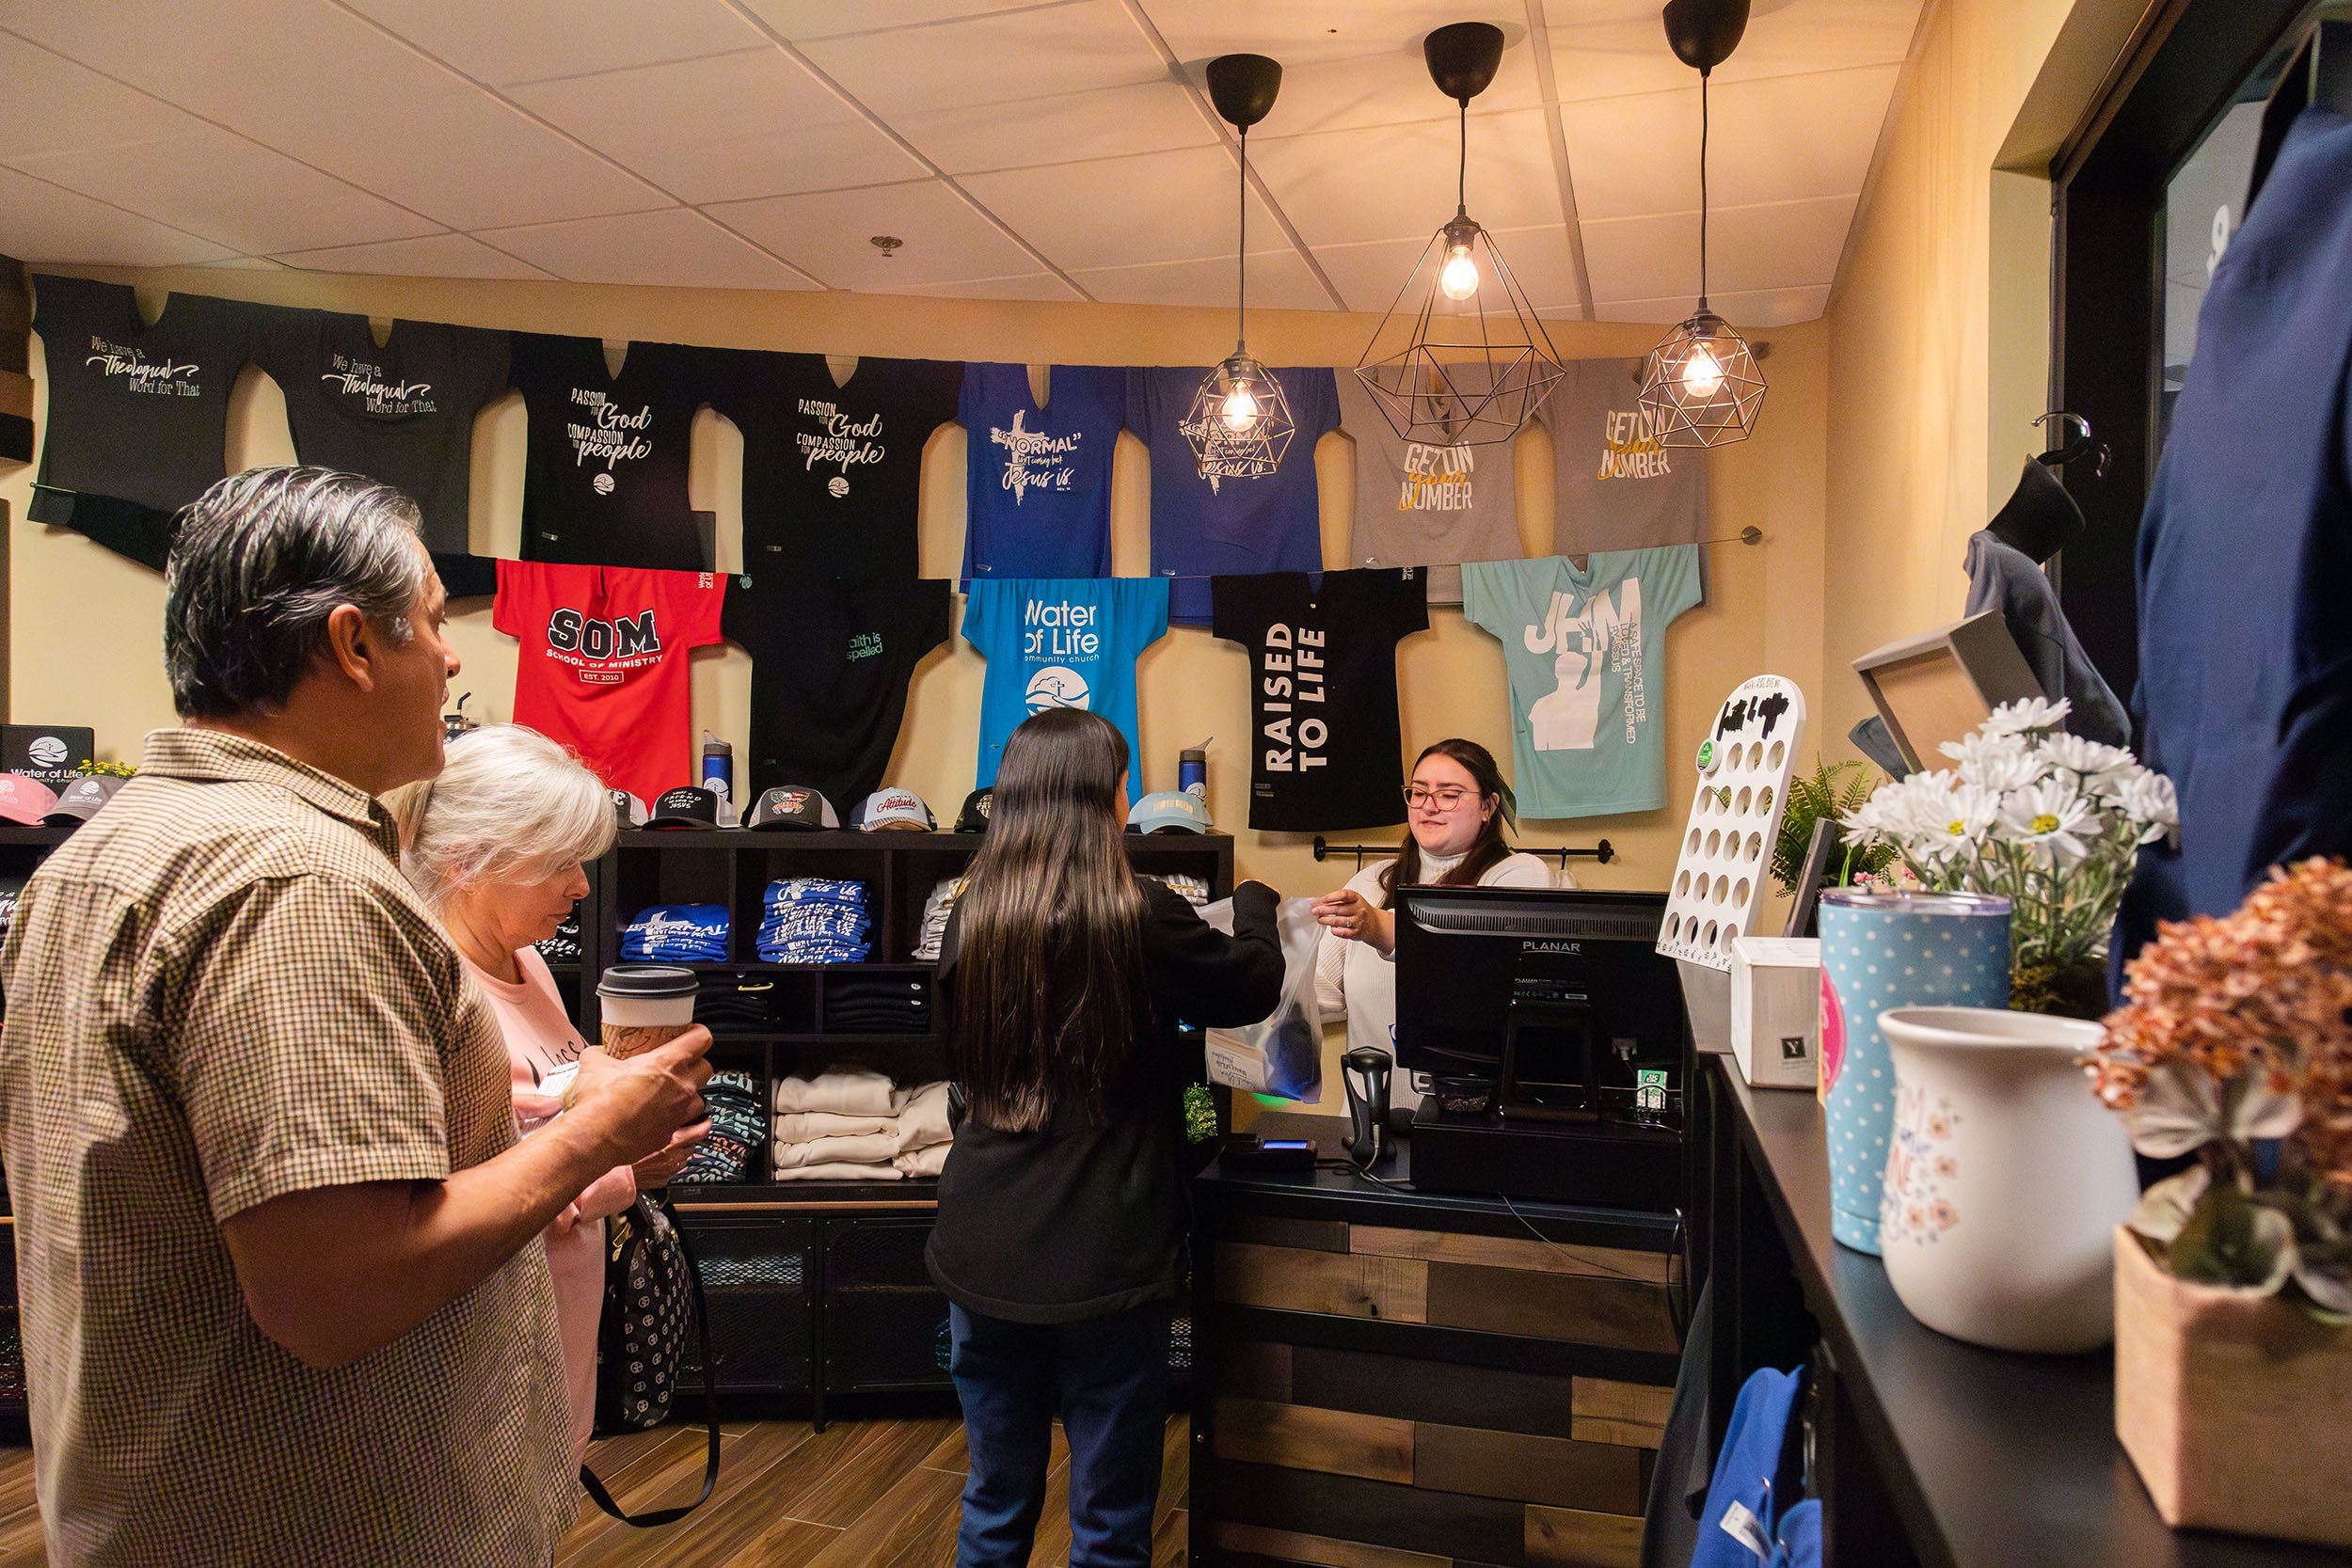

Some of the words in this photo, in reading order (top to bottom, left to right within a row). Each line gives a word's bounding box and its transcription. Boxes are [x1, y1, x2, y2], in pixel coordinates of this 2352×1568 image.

[91, 335, 107, 353] We
[86, 355, 199, 385] Theological
[332, 354, 347, 372] We
[129, 377, 155, 394] Word
[158, 380, 173, 395] for
[176, 380, 200, 396] That
[321, 373, 432, 404] Theological
[366, 397, 393, 413] Word
[395, 402, 410, 414] for
[411, 400, 437, 413] That
[597, 402, 652, 430] God
[798, 398, 836, 417] PASSION
[567, 422, 624, 445] COMPASSION
[828, 413, 883, 438] God
[1606, 409, 1638, 446] GET
[577, 436, 653, 470] people
[796, 432, 856, 451] COMPASSION
[806, 442, 885, 474] people
[1440, 440, 1474, 476] ON
[1600, 449, 1672, 480] NUMBER
[1002, 462, 1055, 490] Jesus
[1398, 469, 1467, 511] your
[1401, 481, 1473, 511] NUMBER
[1025, 598, 1097, 627] Water
[548, 607, 661, 660] SOM
[849, 633, 872, 648] aith
[872, 631, 882, 644] is
[1053, 628, 1099, 655] Life
[546, 648, 585, 667] SCHOOL
[608, 654, 663, 669] MINISTRY
[846, 641, 883, 663] spelled
[1025, 655, 1066, 664] ommunity
[1069, 654, 1100, 663] church
[1296, 626, 1326, 703] LIFE
[583, 673, 599, 681] EST.
[1263, 623, 1293, 772] RAISED
[1634, 691, 1645, 707] TO
[1636, 708, 1646, 722] BE
[1298, 718, 1328, 772] TO
[49, 769, 61, 778] of
[63, 769, 84, 779] Life
[876, 798, 917, 814] Attitude
[1522, 941, 1581, 952] PLANAR
